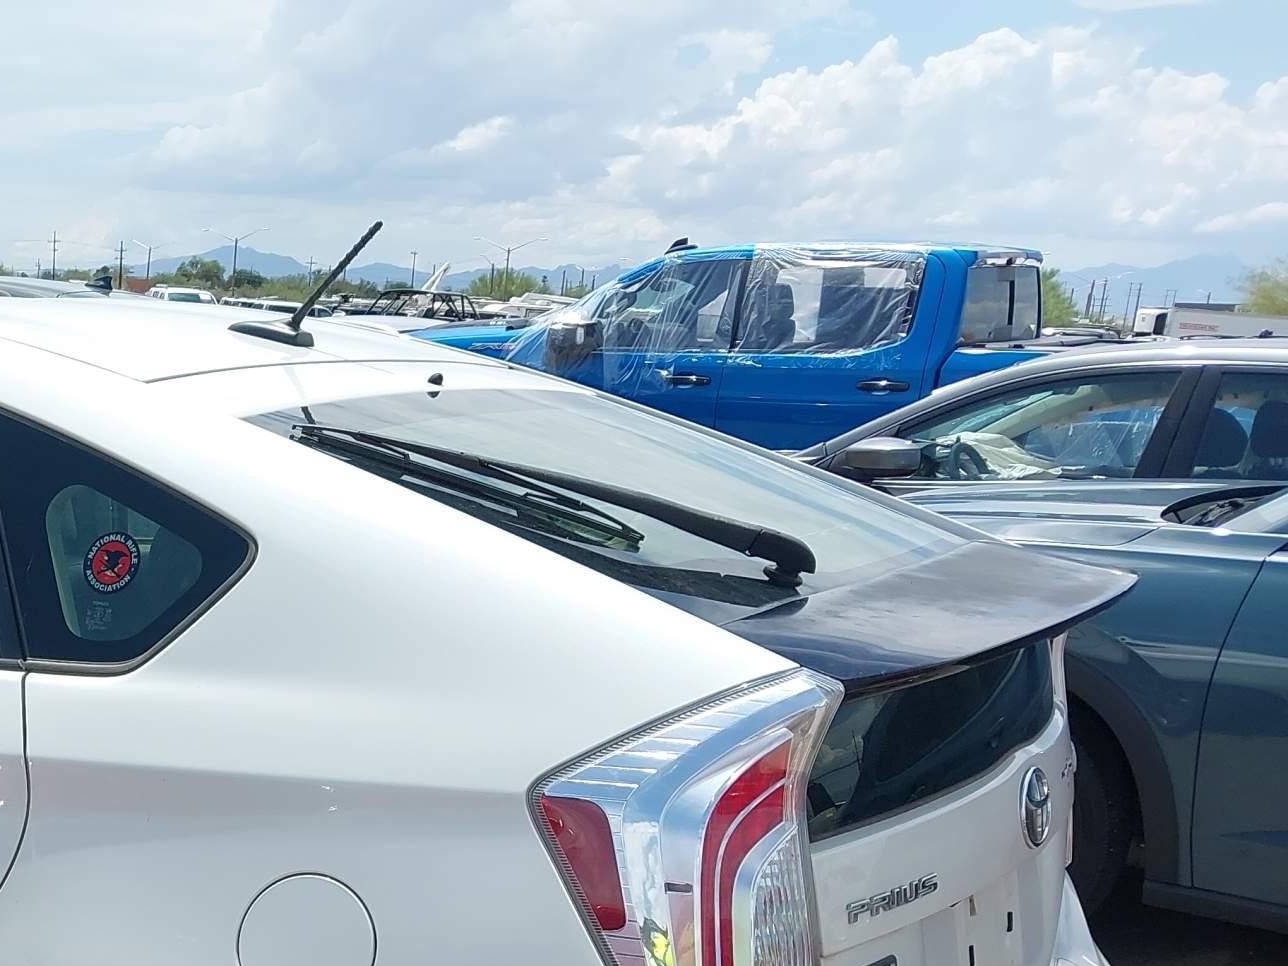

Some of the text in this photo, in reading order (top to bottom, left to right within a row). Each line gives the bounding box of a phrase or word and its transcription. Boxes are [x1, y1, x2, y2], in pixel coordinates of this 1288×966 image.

[88, 533, 138, 565] NATIONAL RIFLE
[86, 569, 131, 592] ASSOCIATION
[846, 872, 939, 925] PRIUS
